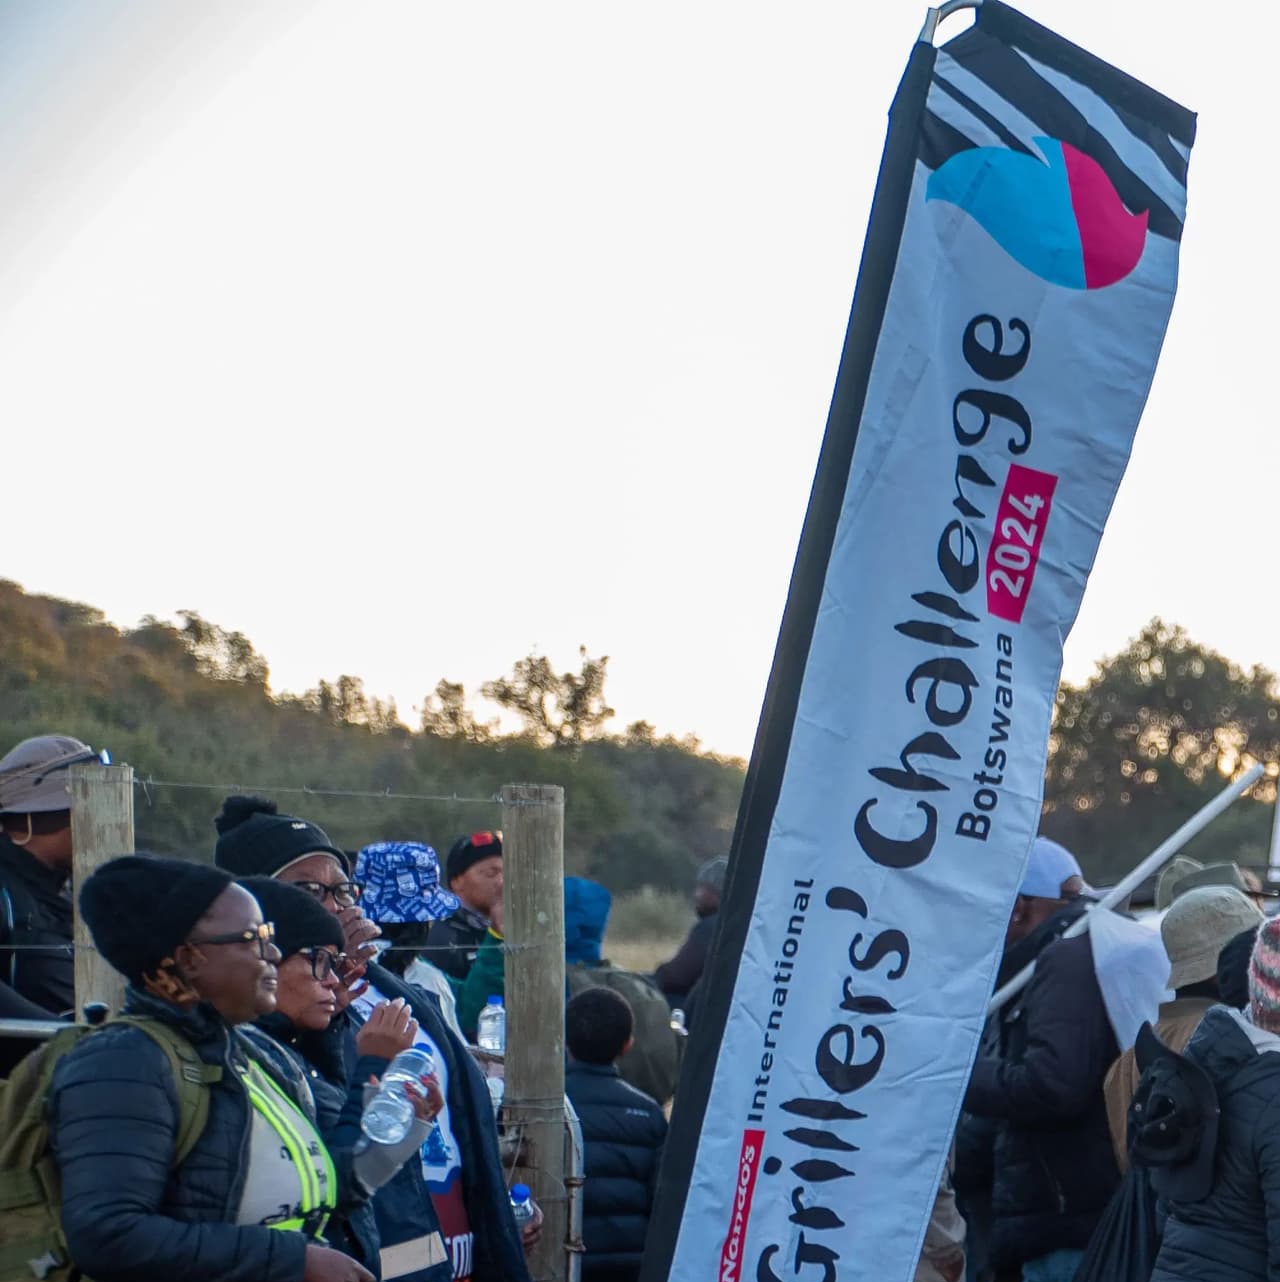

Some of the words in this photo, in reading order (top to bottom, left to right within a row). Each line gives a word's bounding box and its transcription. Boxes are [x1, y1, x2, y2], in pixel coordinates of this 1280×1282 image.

[854, 313, 1032, 869] Challenge
[955, 633, 1013, 841] Botswana
[989, 491, 1045, 599] 2024
[747, 878, 814, 1121] International
